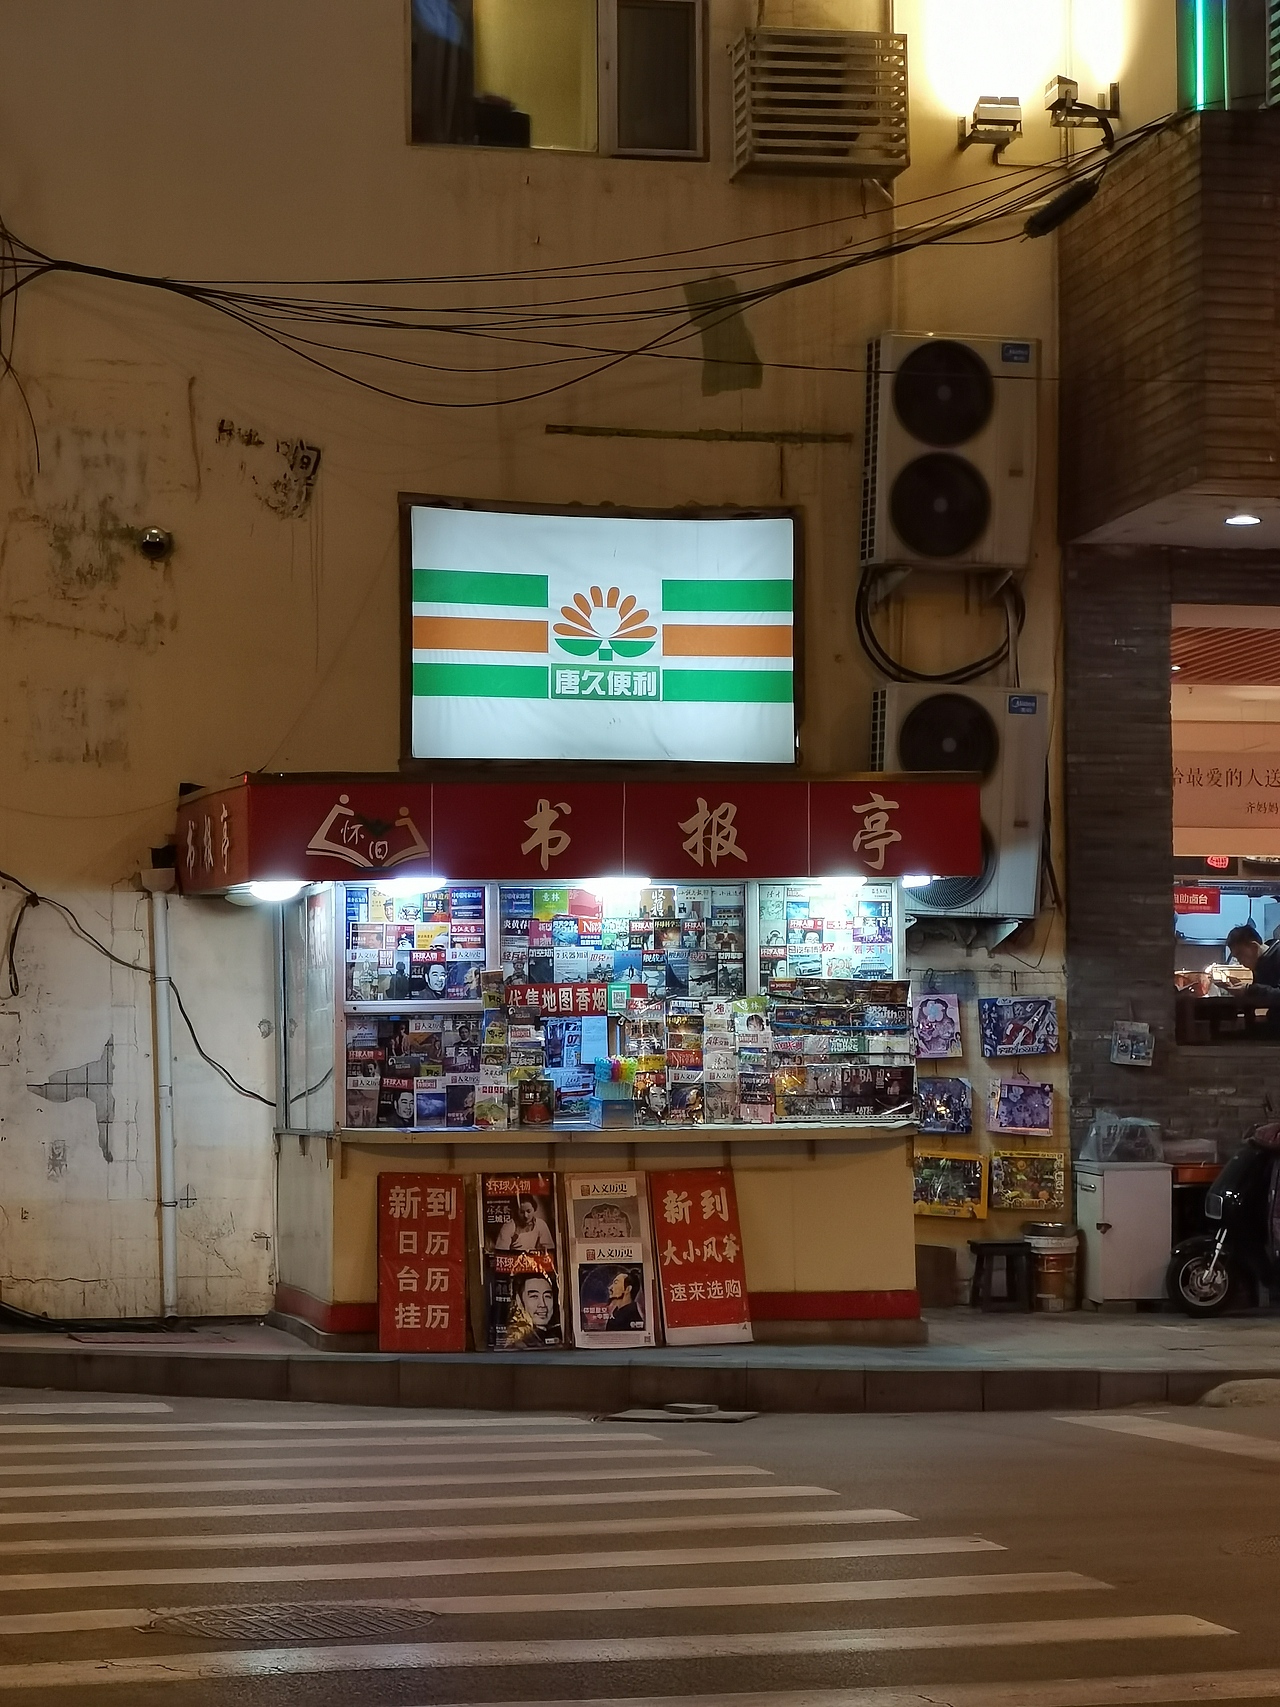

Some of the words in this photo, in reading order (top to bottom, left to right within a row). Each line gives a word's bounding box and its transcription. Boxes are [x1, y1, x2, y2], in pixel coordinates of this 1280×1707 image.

[555, 669, 657, 697] 唐久便利
[340, 819, 389, 861] 怀旧
[521, 792, 902, 871] 书报亭
[503, 919, 530, 929] 炎黄春
[445, 1048, 480, 1060] 看天下
[486, 1180, 531, 1192] 环球人物
[592, 1184, 628, 1193] 人文历史
[388, 1186, 458, 1221] 新到
[662, 1186, 730, 1225] 新到
[398, 1231, 451, 1256] 日历
[597, 1248, 633, 1258] 人文历史
[662, 1233, 741, 1267] 大小风筝
[396, 1266, 451, 1293] 台历
[669, 1278, 742, 1303] 速来选购
[394, 1303, 451, 1330] 挂历
